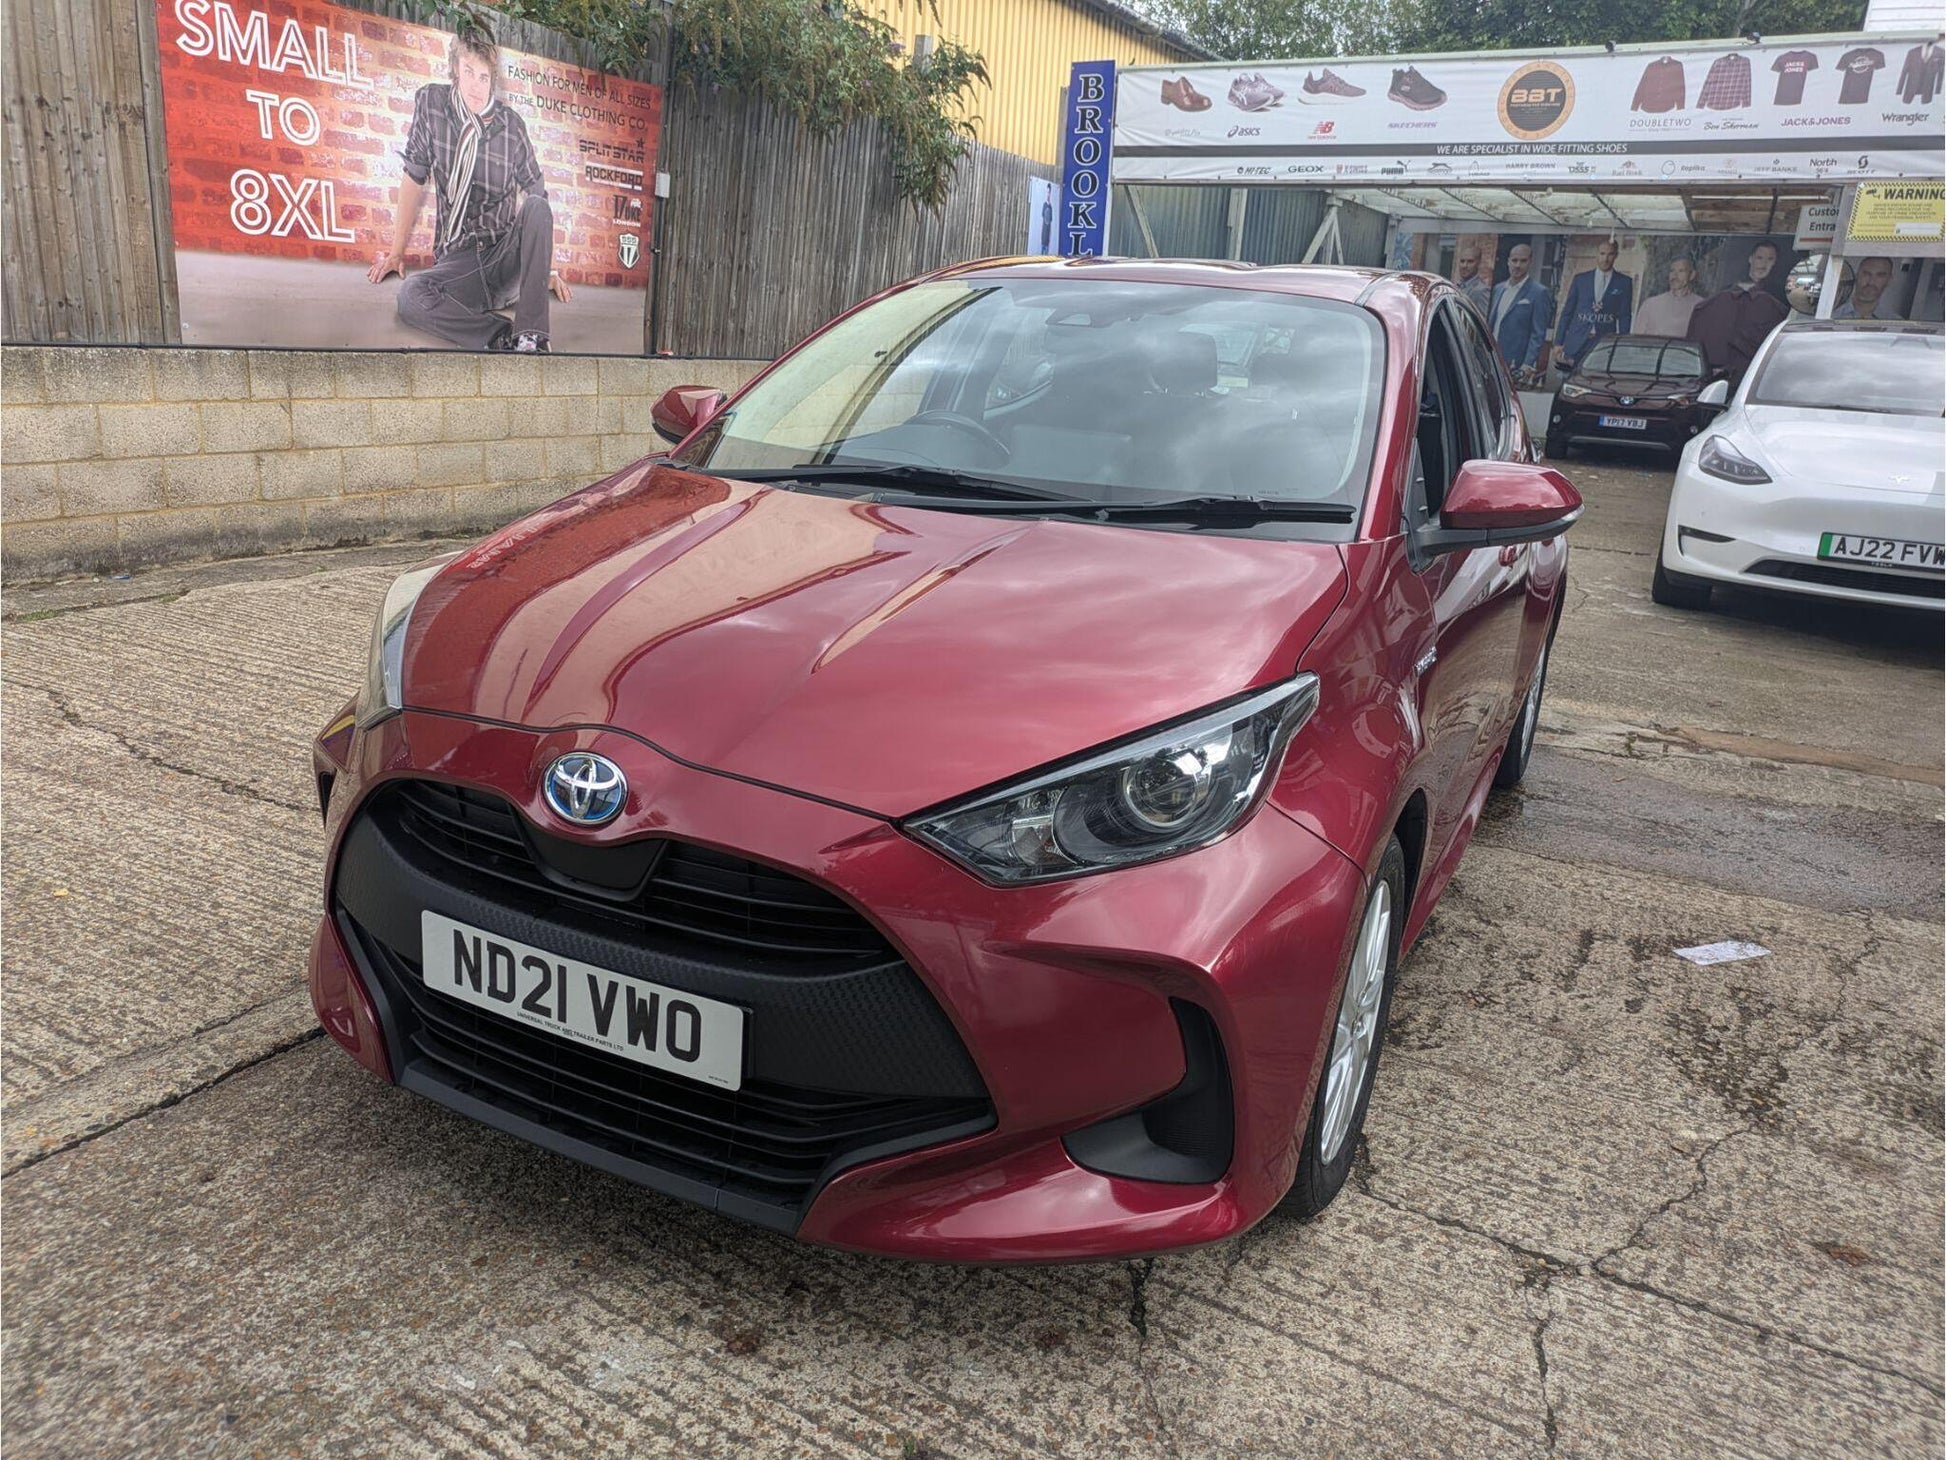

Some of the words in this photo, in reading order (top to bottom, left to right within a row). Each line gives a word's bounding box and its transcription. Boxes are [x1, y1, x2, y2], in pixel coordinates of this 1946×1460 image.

[175, 0, 375, 90] SMALL
[508, 65, 551, 86] FASHION
[552, 76, 570, 90] FOR
[572, 81, 592, 96] MEN
[594, 87, 607, 99] OF
[609, 90, 625, 105] ALL
[627, 95, 651, 110] SIZES
[1510, 88, 1563, 103] BBT
[245, 88, 321, 146] TO
[509, 93, 518, 103] BY
[520, 95, 534, 106] THE
[536, 95, 567, 114] DUKE
[569, 103, 625, 127] CLOTHING
[628, 116, 649, 132] CO.
[1881, 112, 1930, 126] Wrangler
[1629, 118, 1692, 128] DOUBLETWO
[1703, 121, 1720, 131] Ben
[1721, 120, 1760, 131] Sherman
[1436, 145, 1451, 155] WE
[1452, 144, 1469, 154] ARE
[1471, 144, 1520, 154] SPECIALIST
[1520, 143, 1531, 153] IN
[1532, 143, 1556, 153] WIDE
[1557, 143, 1594, 153] FITTING
[1595, 142, 1628, 153] SHOES
[1067, 73, 1105, 256] BROOKL
[1287, 165, 1324, 173] GEOX
[1381, 167, 1404, 176] PUMA
[1809, 158, 1837, 167] North
[585, 165, 643, 189] ROCKFORD
[230, 168, 356, 243] 8XL
[1808, 206, 1839, 217] Custo
[612, 219, 642, 228] LONDON
[1834, 536, 1896, 560] AJ22
[453, 928, 567, 1024] ND21
[586, 973, 702, 1063] VWO
[517, 1011, 543, 1025] UNIVERSAL
[544, 1019, 561, 1032] TRUCK
[573, 1030, 595, 1042] TRAILER
[595, 1037, 613, 1048] PARTS
[613, 1043, 624, 1052] LTD
